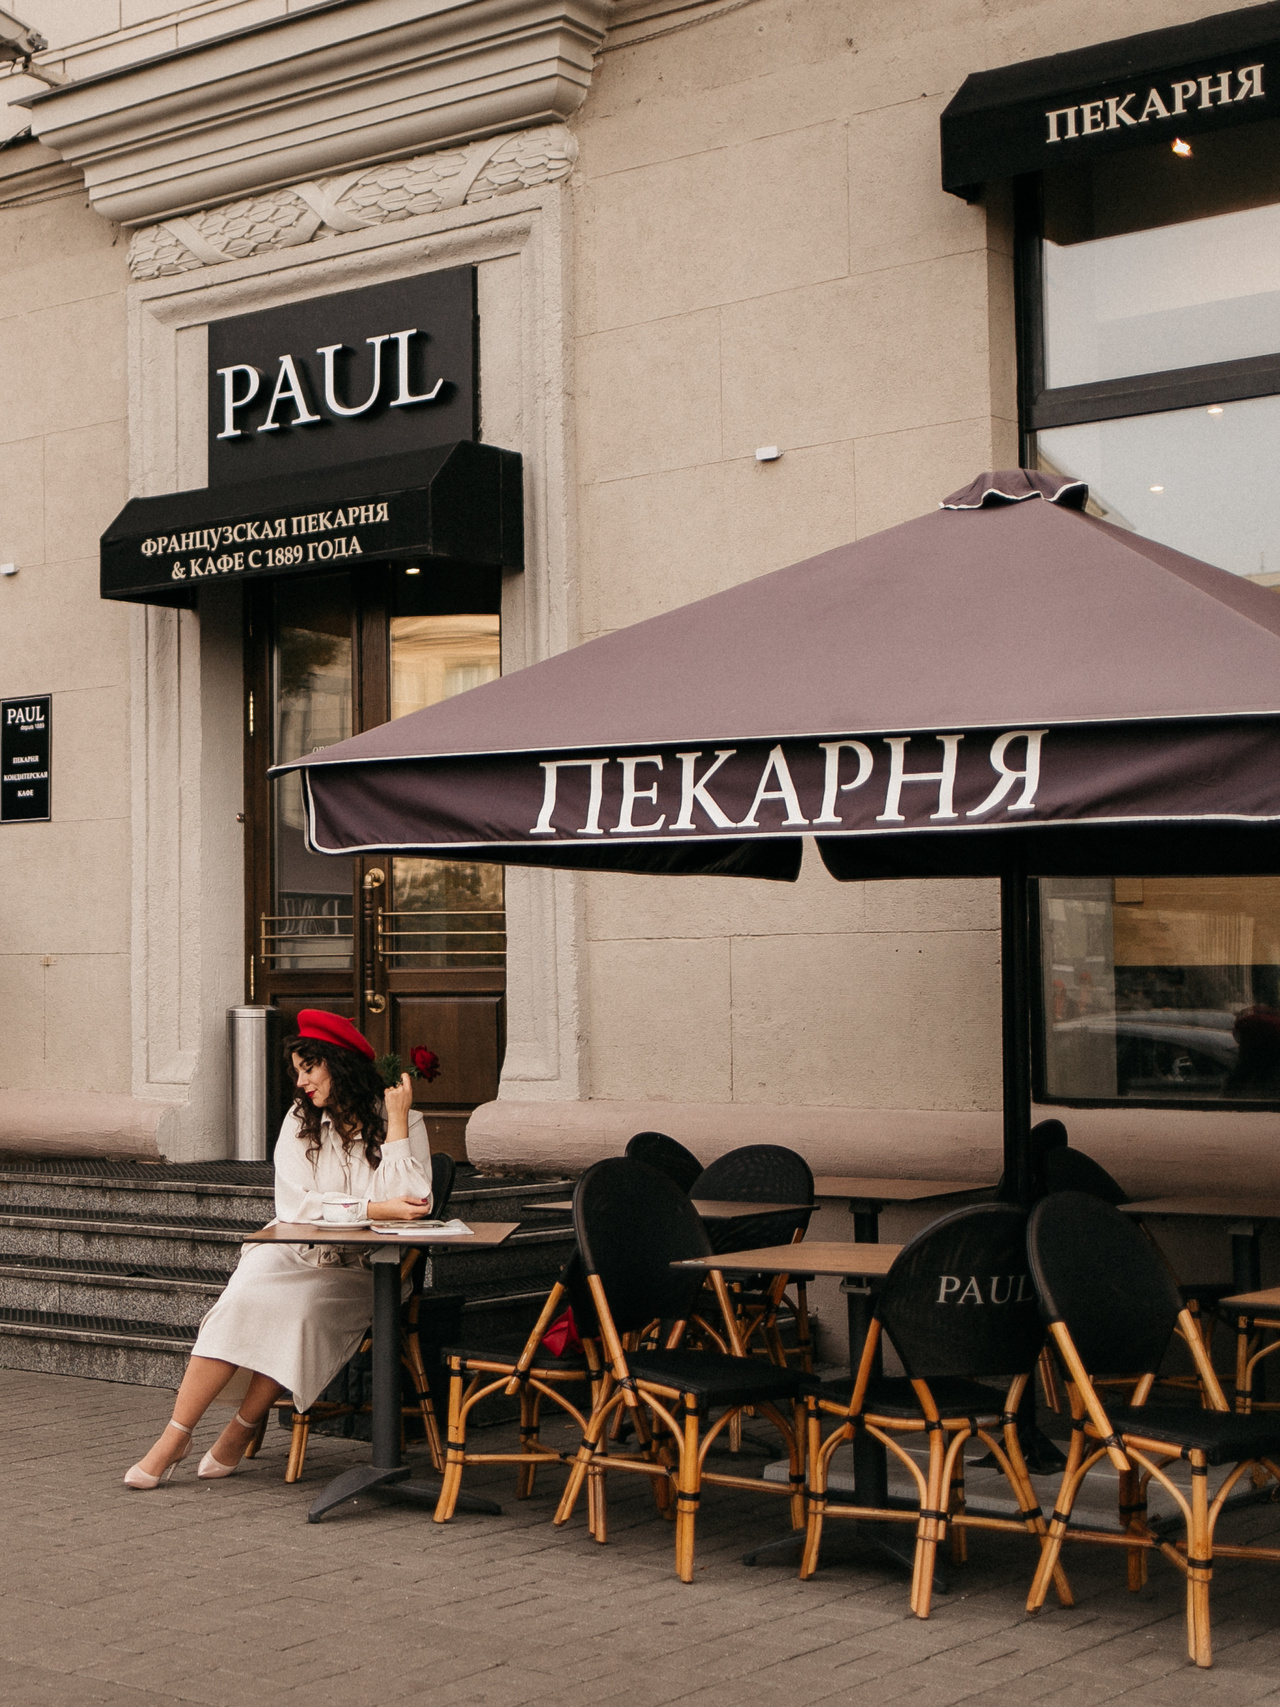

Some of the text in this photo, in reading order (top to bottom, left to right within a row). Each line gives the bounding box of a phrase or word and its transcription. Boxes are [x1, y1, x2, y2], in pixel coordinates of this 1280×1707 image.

[1045, 64, 1265, 143] ПЕКАРНЯ
[216, 328, 444, 439] PAUL
[141, 502, 389, 557] ФРАНЦУЗСКАЯ ПЕКАРНЯ
[172, 561, 186, 580] &
[190, 552, 244, 577] КАФЕ
[266, 545, 303, 567] 1889
[308, 535, 362, 562] ГОДА
[7, 705, 45, 724] PAUL
[17, 789, 34, 797] КАФЕ
[529, 729, 1049, 834] ПЕКАРНЯ
[936, 1275, 1033, 1304] PAUL
